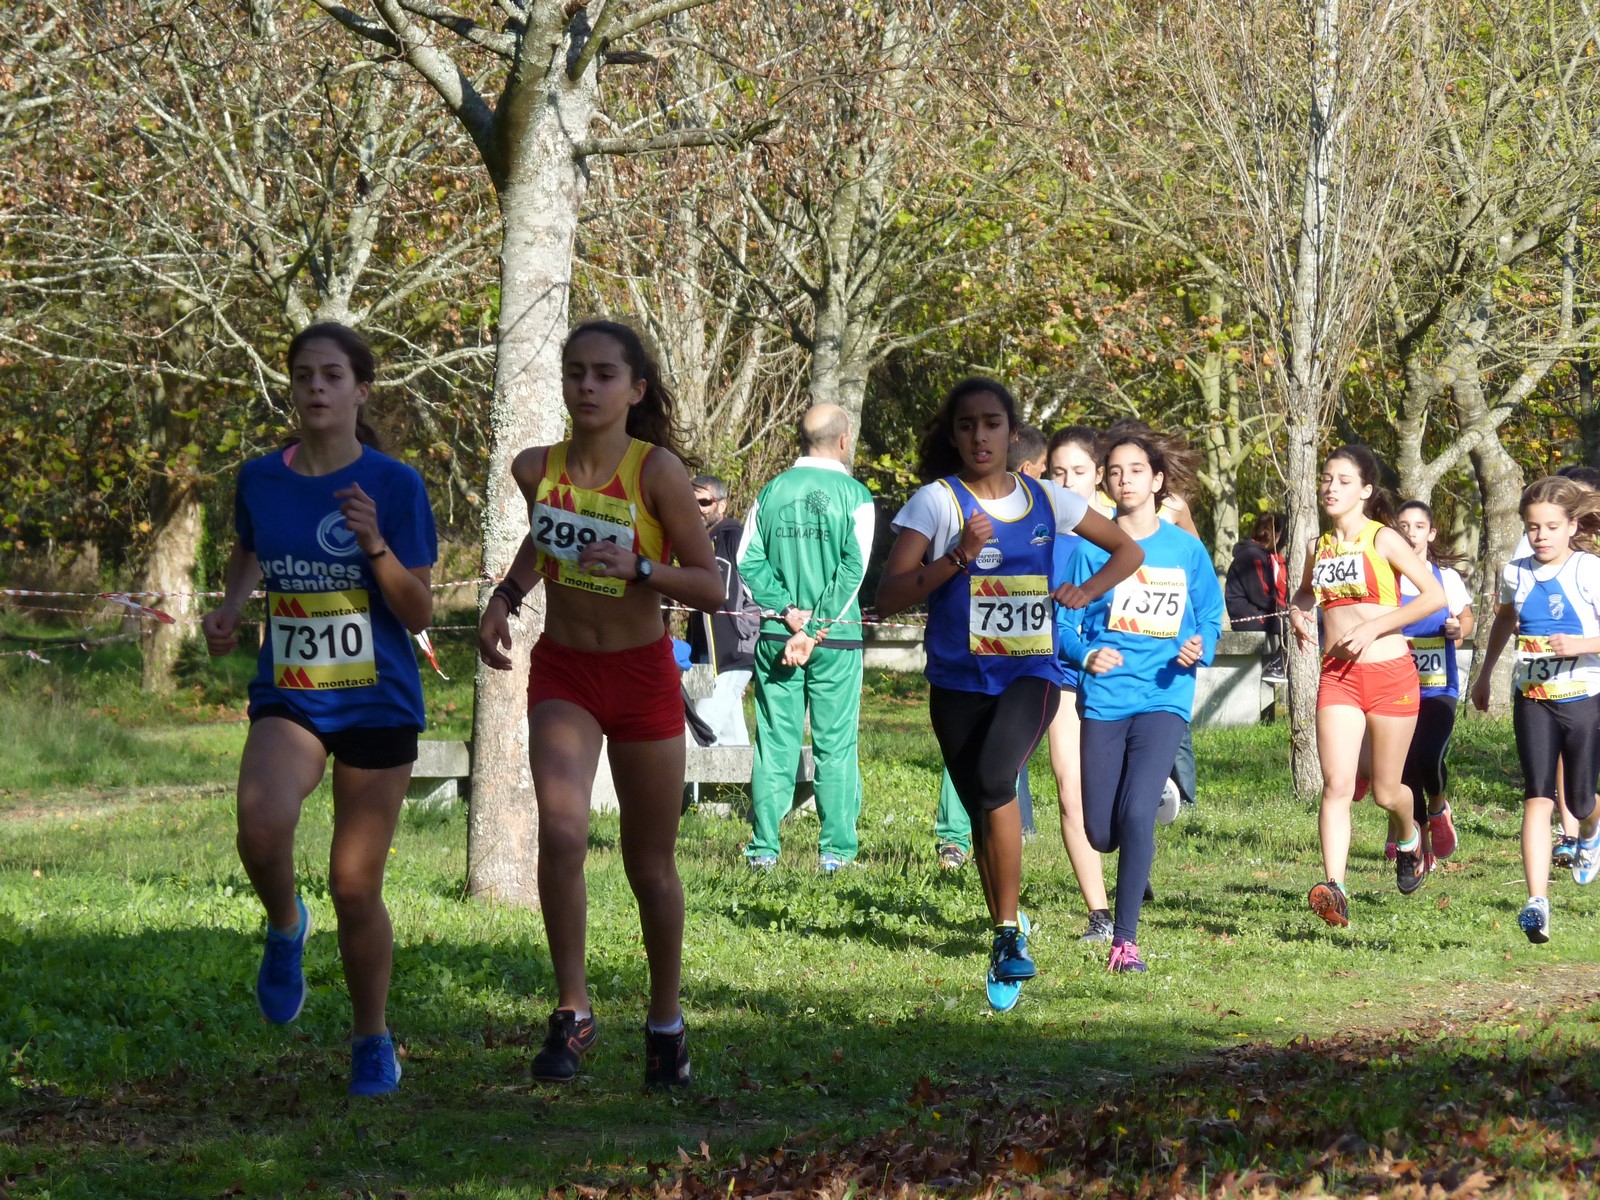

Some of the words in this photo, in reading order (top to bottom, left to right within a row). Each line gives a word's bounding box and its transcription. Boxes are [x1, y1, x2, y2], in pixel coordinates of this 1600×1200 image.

[580, 507, 631, 527] montaco
[1316, 559, 1358, 585] 7364
[564, 576, 618, 595] montaco
[1012, 589, 1048, 597] montaco
[311, 605, 368, 618] montaco
[977, 601, 1046, 633] 7319
[278, 622, 363, 660] 7310
[1142, 629, 1178, 637] montaco
[1011, 647, 1052, 656] montaco
[1522, 655, 1579, 681] 7377
[317, 677, 375, 688] montaco
[1549, 688, 1587, 699] montaco
